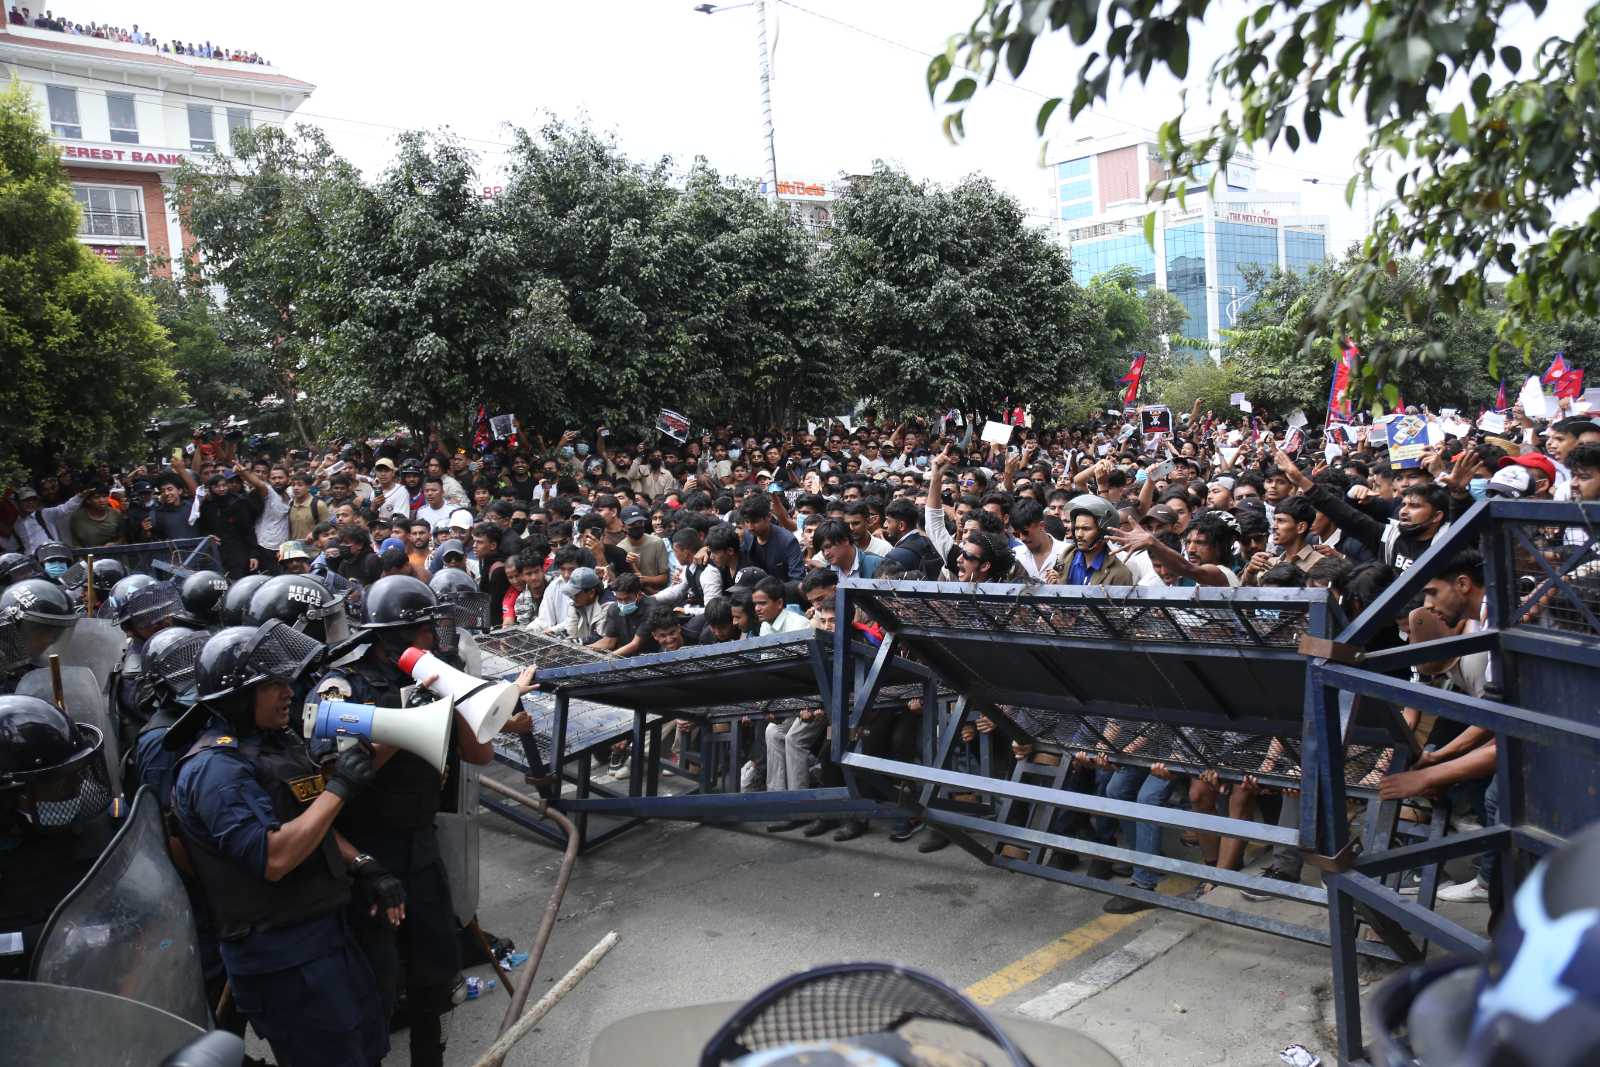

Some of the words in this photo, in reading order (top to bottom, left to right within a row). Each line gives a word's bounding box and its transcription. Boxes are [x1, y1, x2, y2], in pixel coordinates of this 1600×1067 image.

[131, 151, 184, 164] BANK
[1242, 214, 1257, 224] NEXT
[289, 585, 320, 598] NEPAL
[288, 592, 320, 607] POLICE
